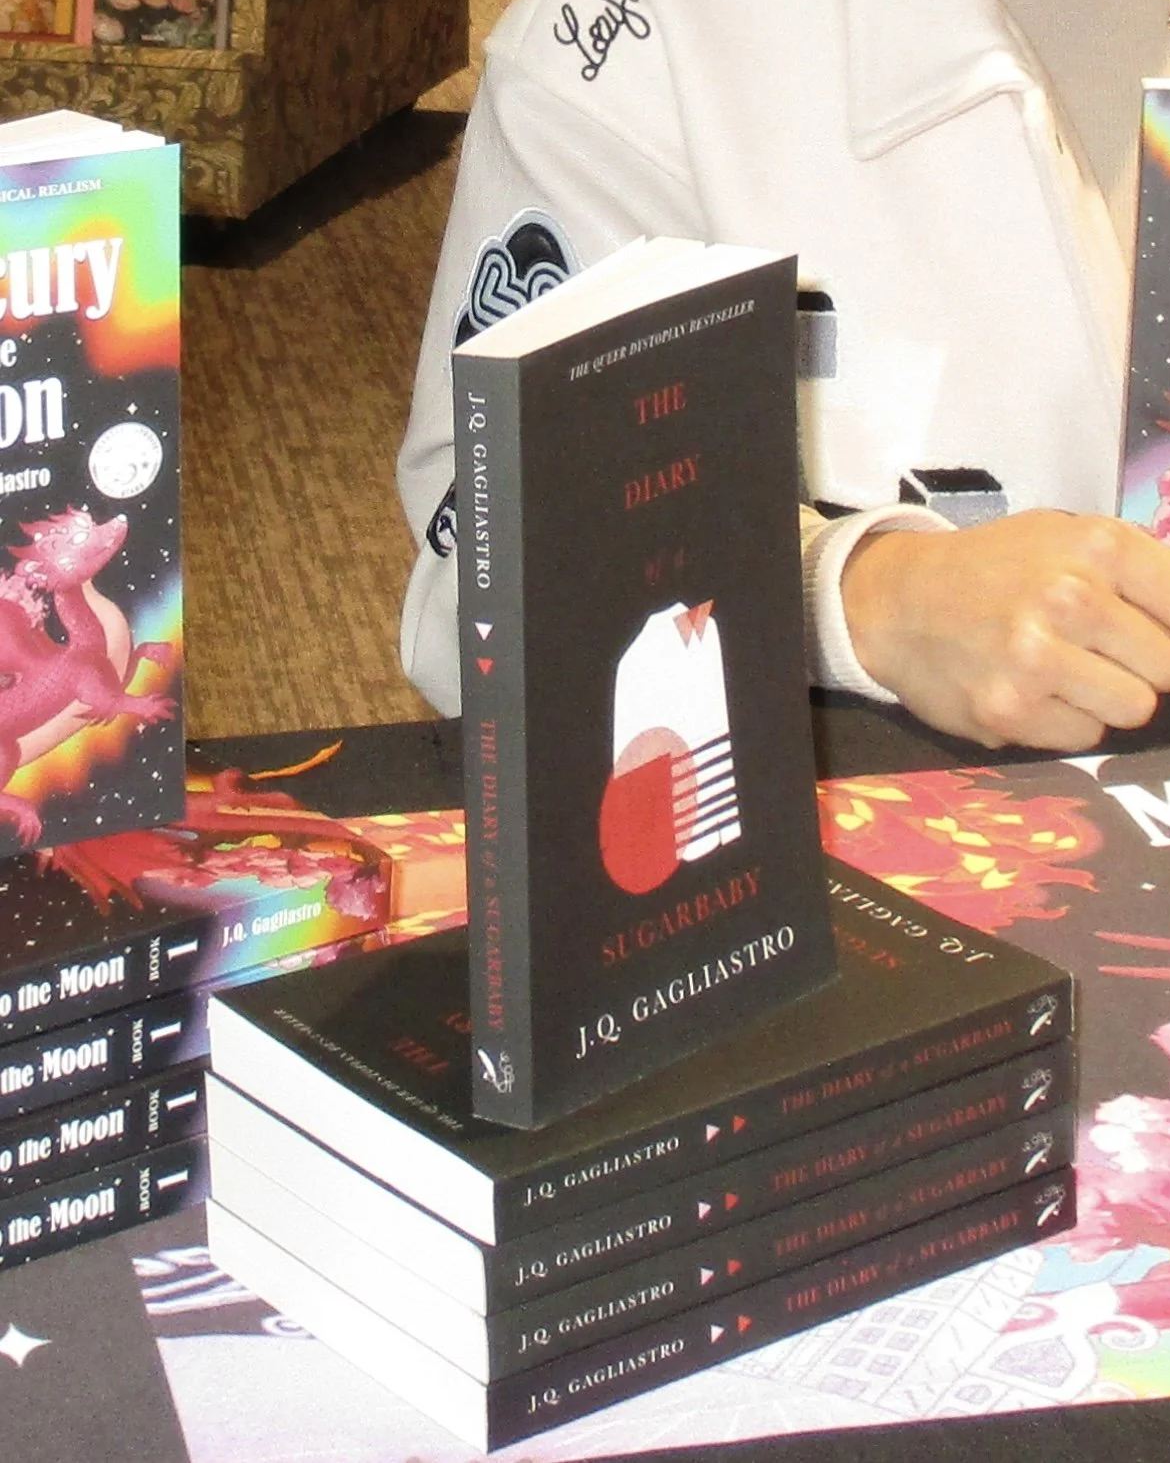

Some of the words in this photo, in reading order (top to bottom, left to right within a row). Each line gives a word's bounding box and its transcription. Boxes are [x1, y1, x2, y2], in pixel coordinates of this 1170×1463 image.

[38, 177, 102, 198] REALISM
[570, 362, 591, 381] THE
[592, 345, 628, 374] QUEER
[628, 324, 687, 358] DYSTOPIAN
[688, 298, 756, 334] BESTSELLER
[468, 391, 487, 434] J.Q.
[634, 382, 687, 426] THE
[472, 442, 492, 590] GAGLIASTRO
[623, 453, 702, 510] DIARY
[479, 720, 497, 764] THE
[481, 773, 499, 841] DIARY
[17, 981, 52, 1013] the
[58, 955, 126, 1001] Moon
[148, 936, 162, 982] BOOK
[221, 924, 249, 948] J.Q.
[250, 900, 323, 937] Gagliastro
[601, 866, 762, 968] SUGARBABY
[483, 894, 505, 1030] SUGARBABY
[575, 1012, 622, 1060] J.Q.
[631, 925, 795, 1023] GAGLIASTRO
[40, 1037, 109, 1084] Moon
[131, 1018, 144, 1064] BOOK
[17, 1136, 52, 1167] the
[58, 1107, 126, 1154] Moon
[147, 1089, 161, 1133] BOOK
[523, 1180, 557, 1207] J.Q.
[563, 1136, 681, 1189] GAGLIASTRO
[781, 1090, 816, 1115] THE
[821, 1068, 875, 1098] DIARY
[8, 1215, 42, 1246] the
[49, 1186, 117, 1233] Moon
[139, 1166, 151, 1213] BOOK
[514, 1259, 549, 1287] J.Q.
[555, 1214, 673, 1268] GAGLIASTRO
[771, 1165, 810, 1191] THE
[814, 1146, 868, 1178] DIARY
[518, 1326, 552, 1355] J.Q.
[557, 1280, 676, 1336] GAGLIASTRO
[775, 1231, 811, 1257] THE
[816, 1211, 869, 1242] DIARY
[527, 1386, 562, 1415] J.Q.
[567, 1337, 686, 1395] GAGLIASTRO
[785, 1287, 822, 1314] THE
[826, 1267, 880, 1298] DIARY
